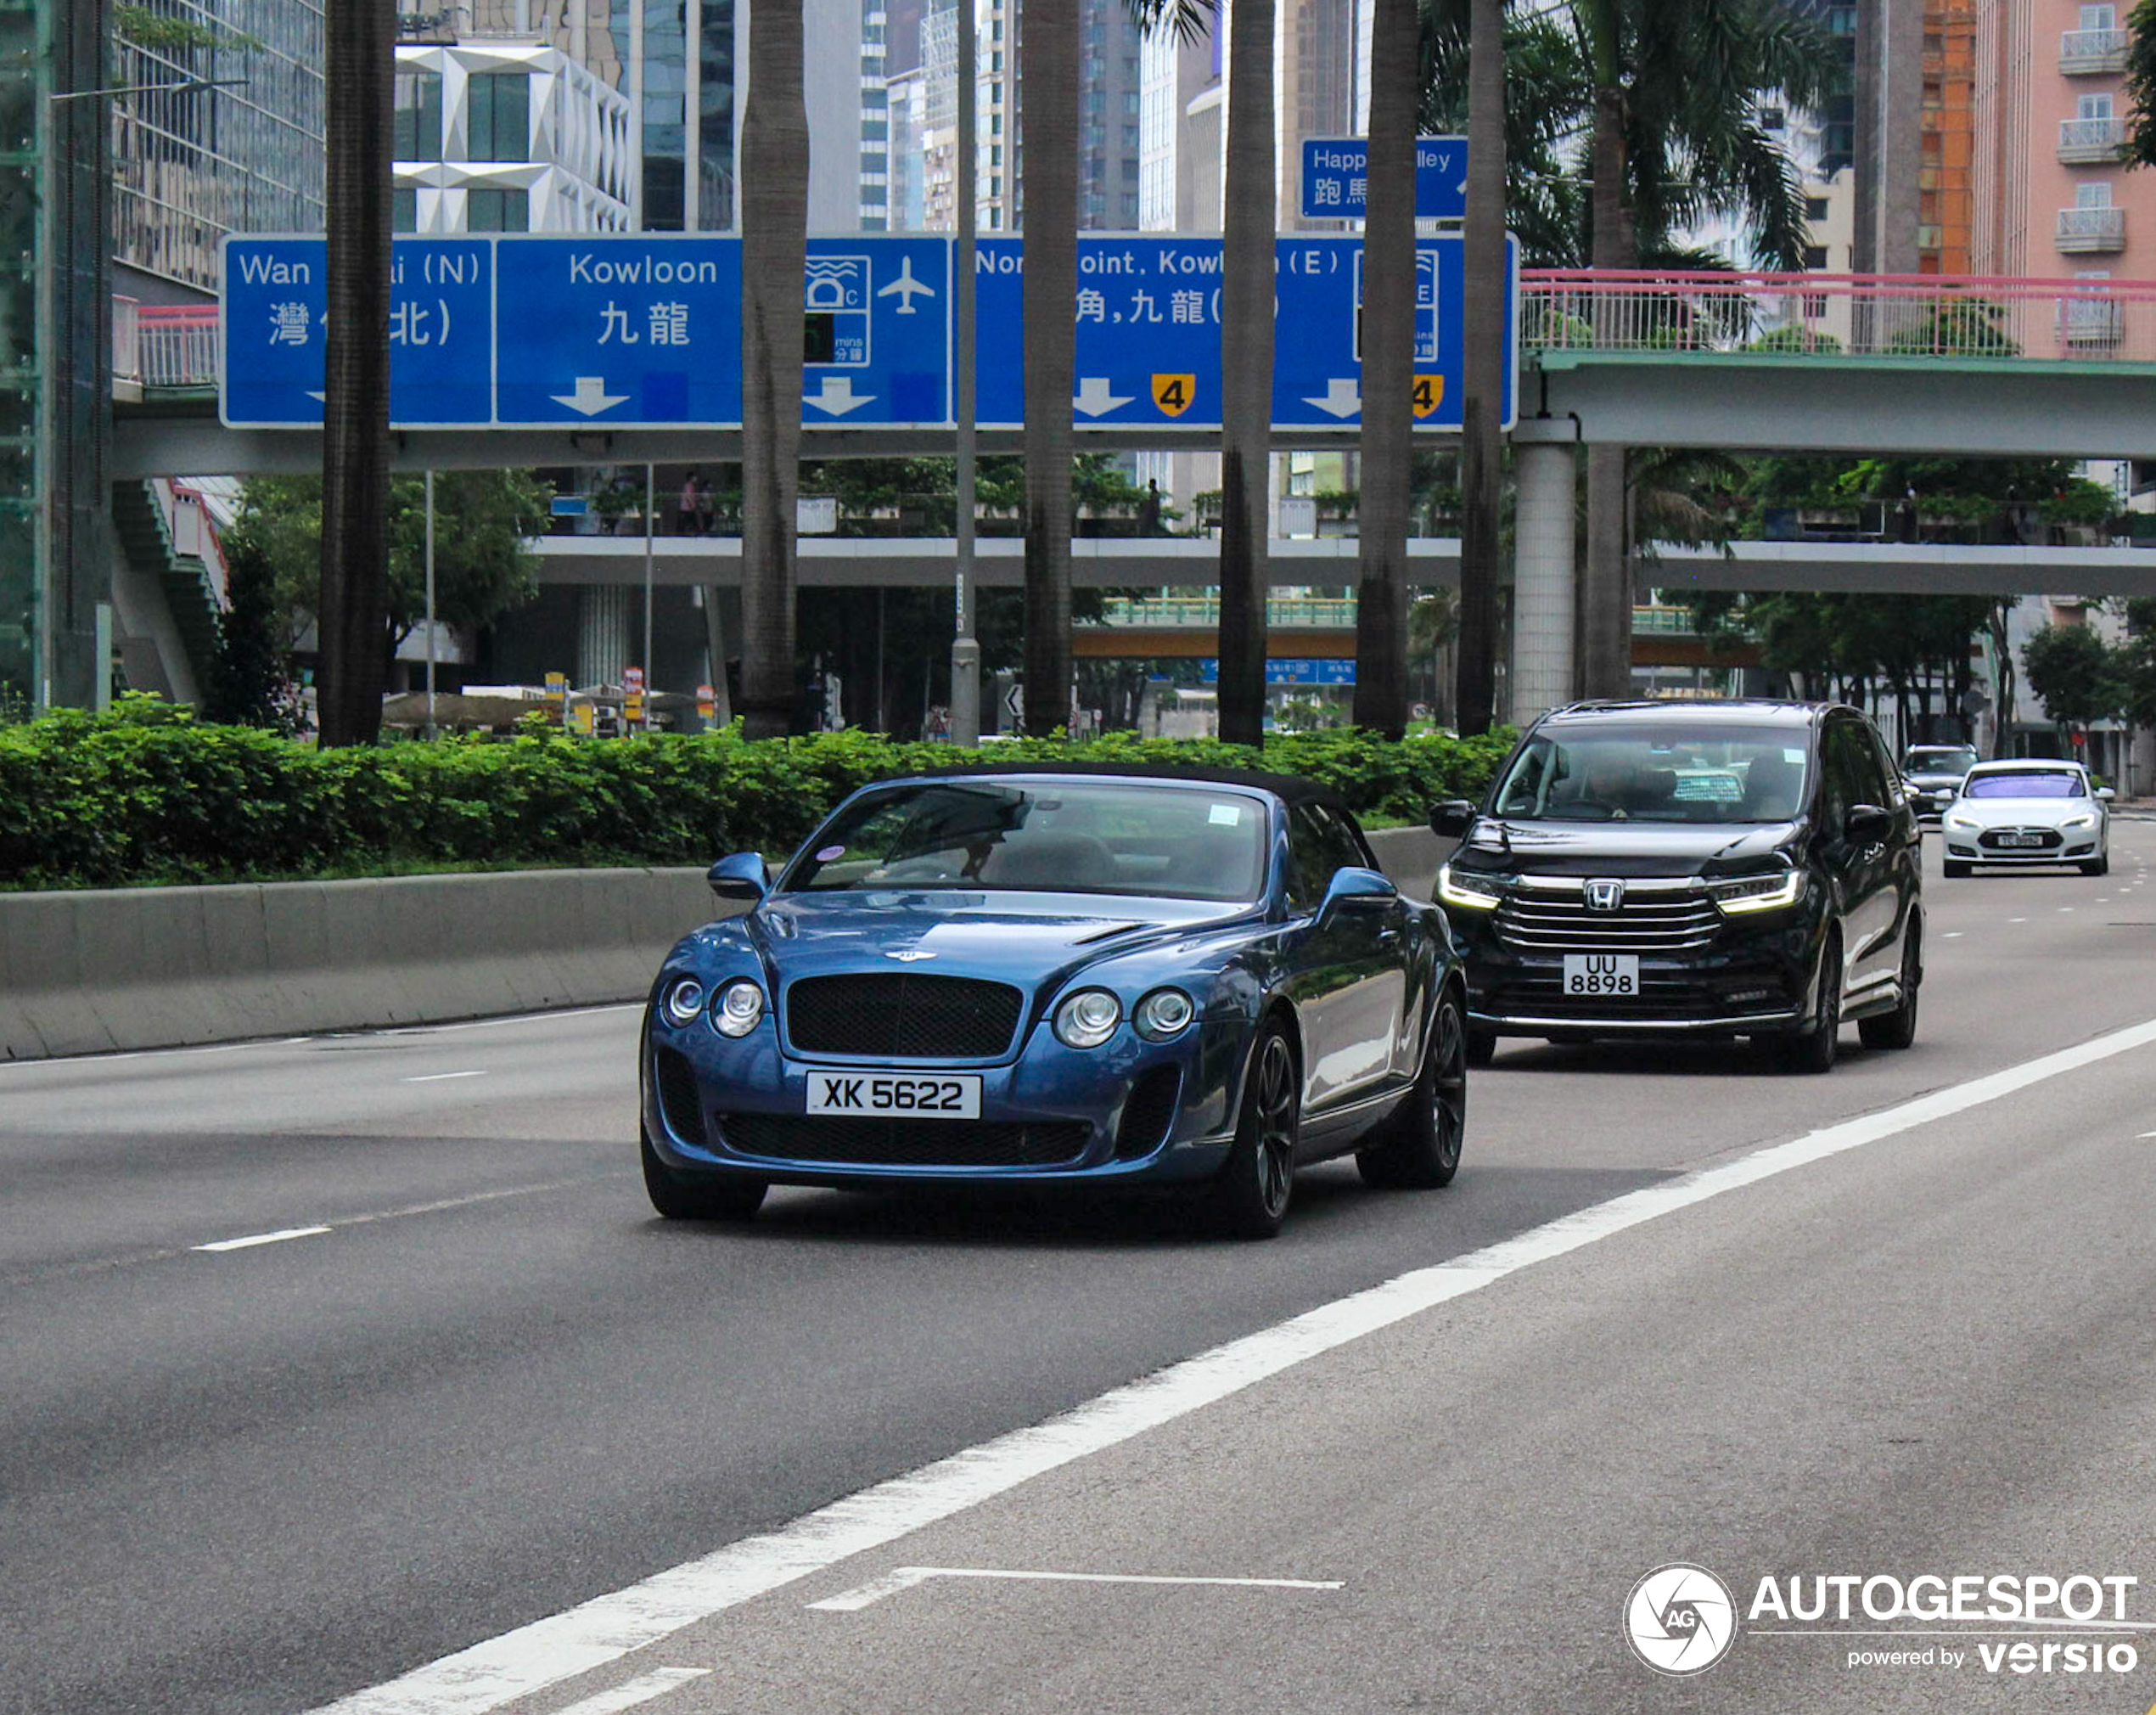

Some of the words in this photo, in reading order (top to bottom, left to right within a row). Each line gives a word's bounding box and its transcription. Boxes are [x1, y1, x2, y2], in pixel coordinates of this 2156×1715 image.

[1314, 150, 1367, 172] Happ
[1417, 150, 1451, 172] lley
[1314, 177, 1367, 205] 跑馬
[239, 255, 310, 284] Wan
[424, 253, 479, 284] (N)
[570, 254, 716, 284] Kowloon
[975, 250, 1024, 274] Nor
[1080, 250, 1146, 276] oint,
[1289, 250, 1338, 274] (E)
[845, 290, 858, 306] C
[597, 301, 690, 346] 九龍
[1159, 380, 1186, 409] 4
[1412, 380, 1434, 409] 4
[1586, 956, 1617, 975] UU
[1570, 975, 1633, 993] 8898
[823, 1078, 864, 1109] XK
[872, 1079, 963, 1111] 5622
